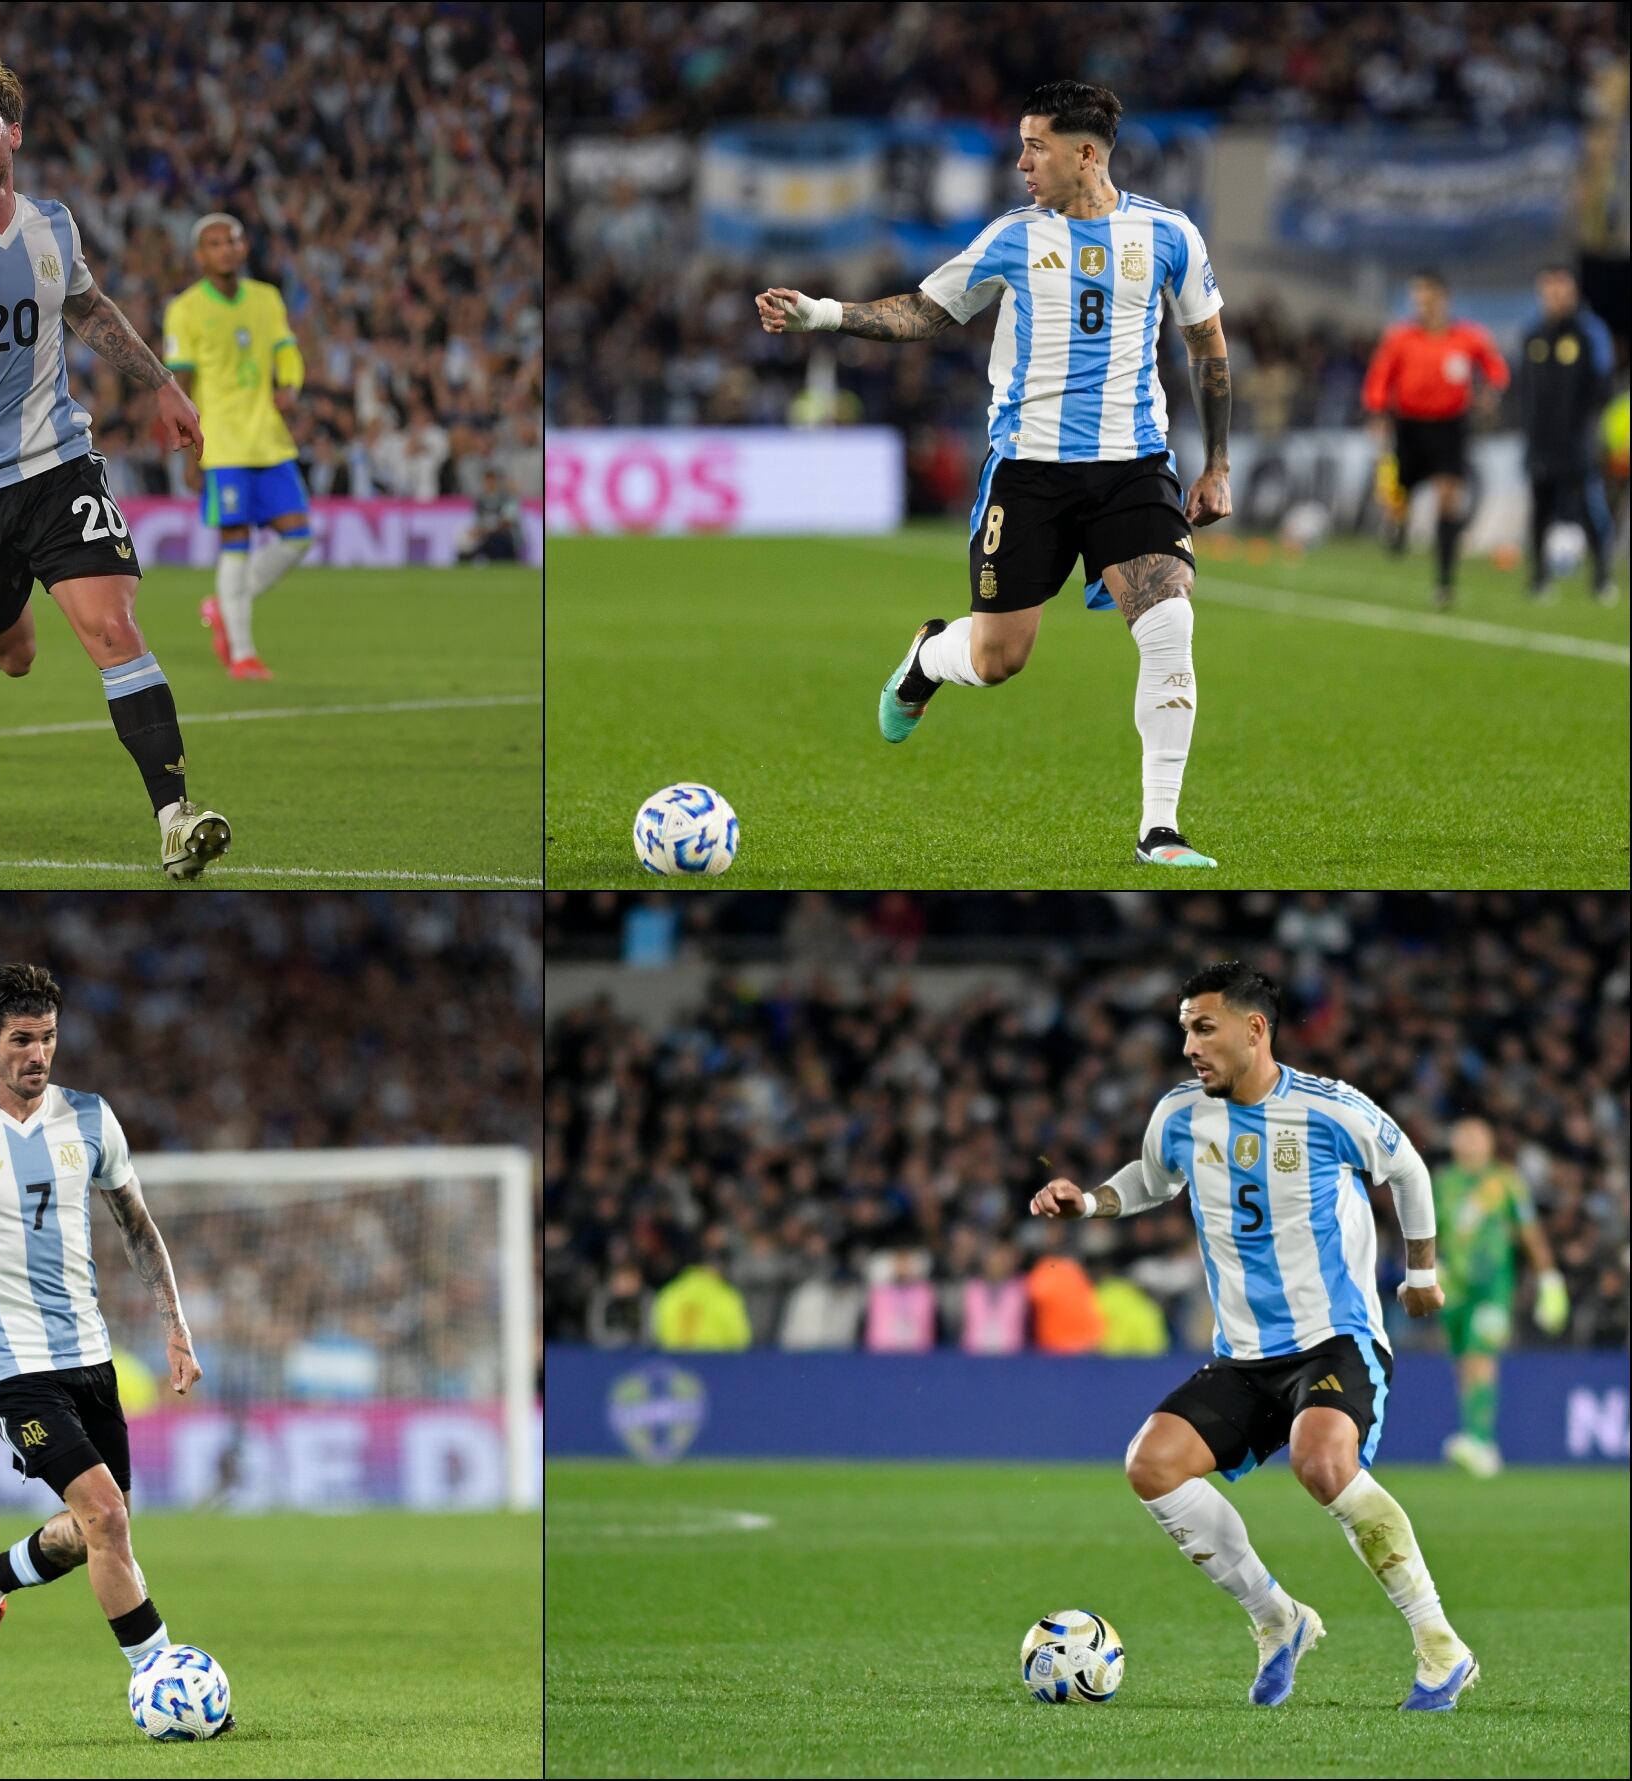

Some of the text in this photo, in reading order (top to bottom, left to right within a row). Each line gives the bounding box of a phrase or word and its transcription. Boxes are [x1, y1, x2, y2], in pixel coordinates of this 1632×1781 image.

[1080, 289, 1104, 334] 8
[71, 495, 128, 542] 20
[983, 505, 1005, 555] 8
[26, 1182, 51, 1231] 7
[1238, 1184, 1264, 1233] 5
[21, 1420, 48, 1448] AFA
[174, 1415, 370, 1513] DE
